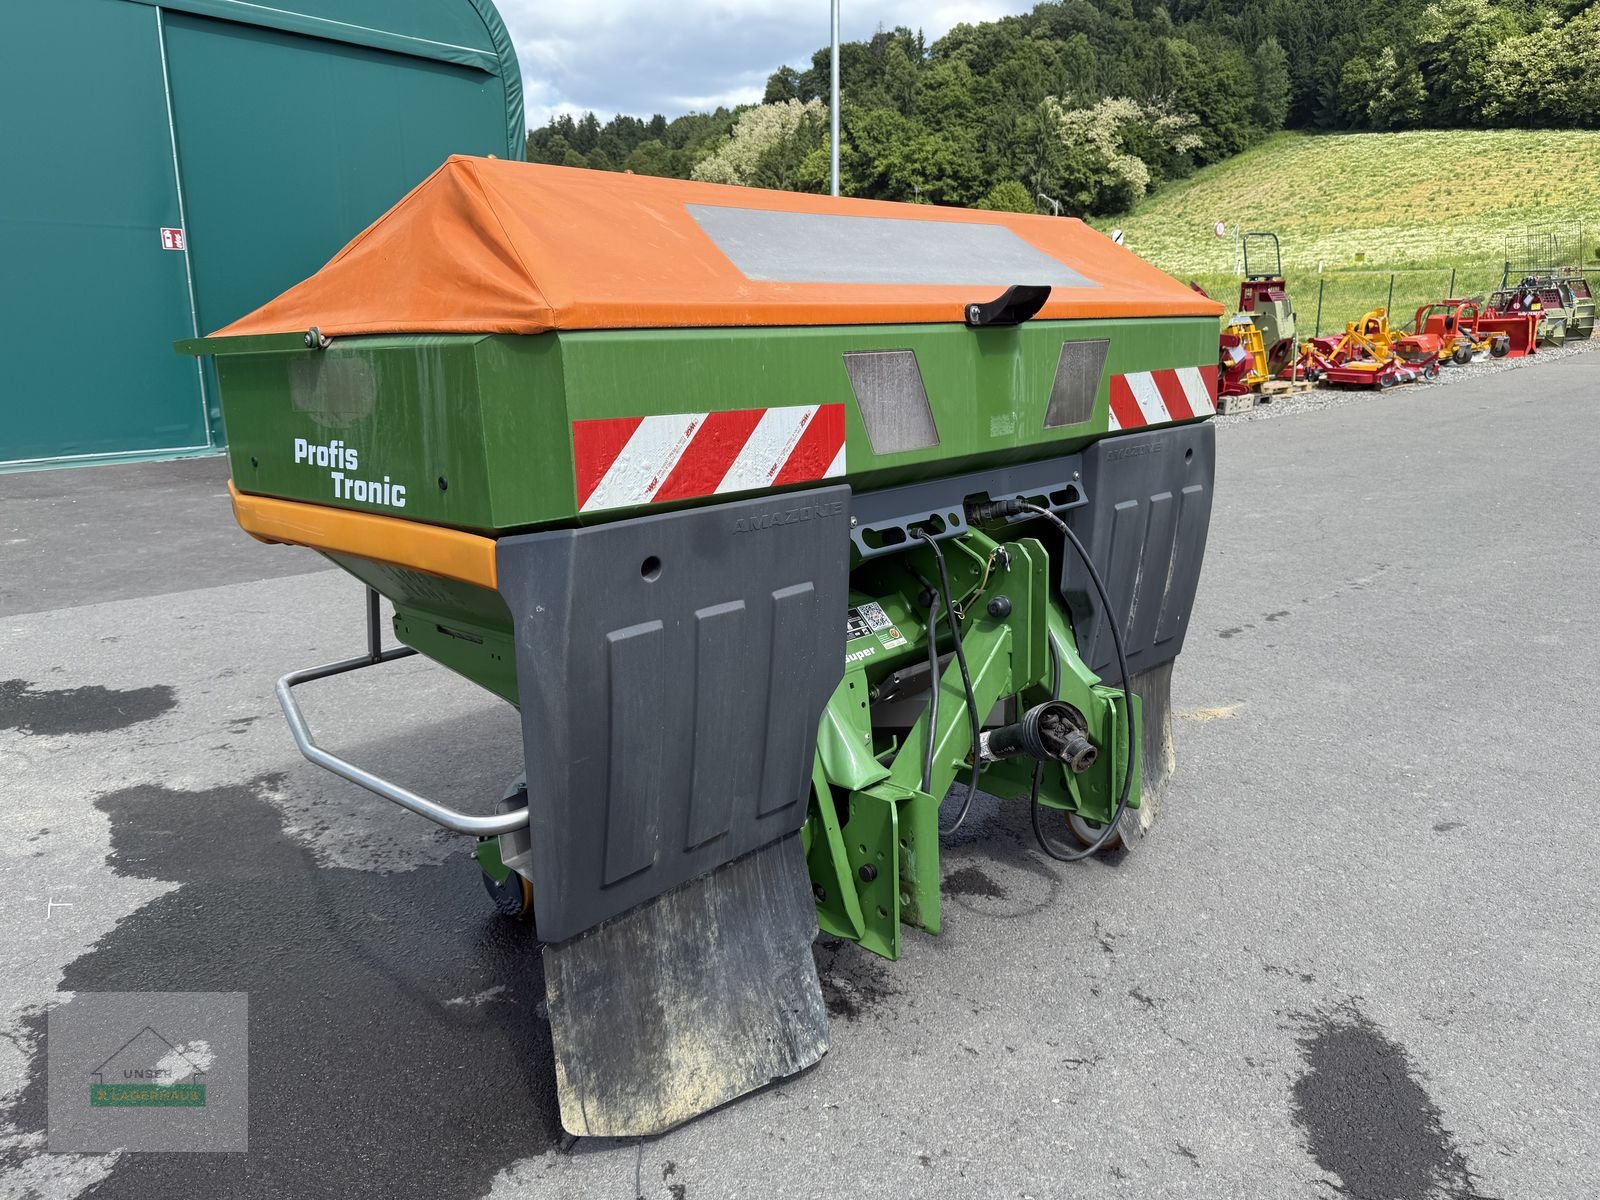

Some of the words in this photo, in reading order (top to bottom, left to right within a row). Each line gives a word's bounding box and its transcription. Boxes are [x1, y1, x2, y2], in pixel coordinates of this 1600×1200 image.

[294, 438, 358, 470] Profis
[331, 471, 406, 507] Tronic
[732, 501, 842, 535] AMAZONE
